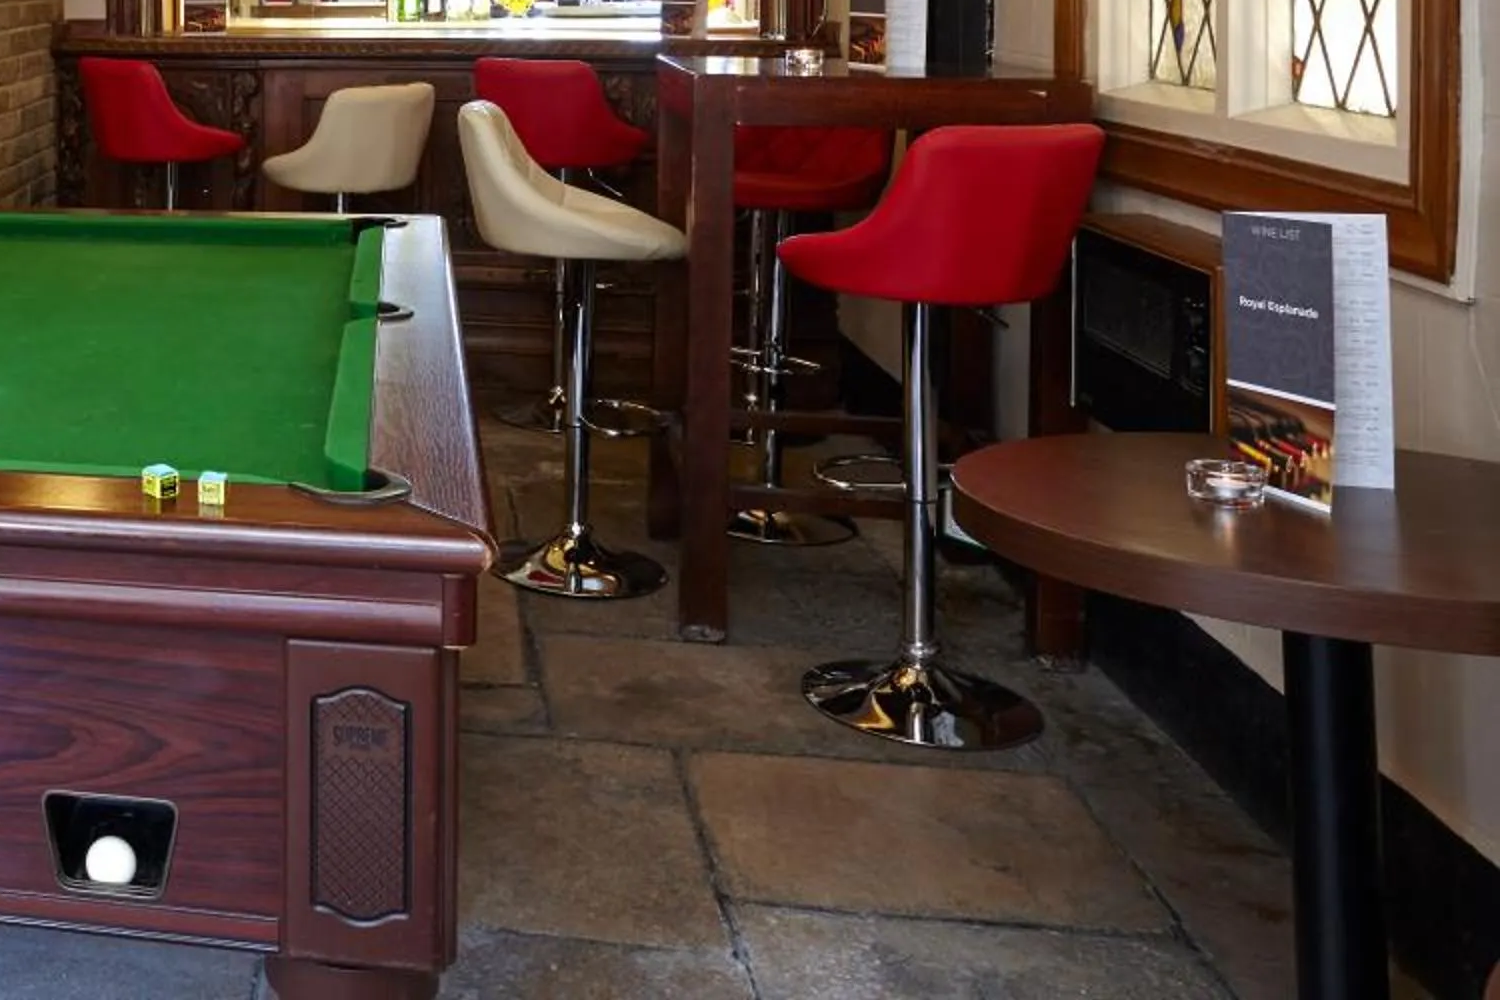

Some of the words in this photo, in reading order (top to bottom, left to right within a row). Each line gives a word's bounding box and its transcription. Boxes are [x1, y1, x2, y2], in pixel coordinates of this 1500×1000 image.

[1251, 225, 1278, 239] WINE
[1279, 228, 1301, 241] LIST
[1238, 295, 1267, 311] Royal
[1267, 300, 1320, 320] Esplanade
